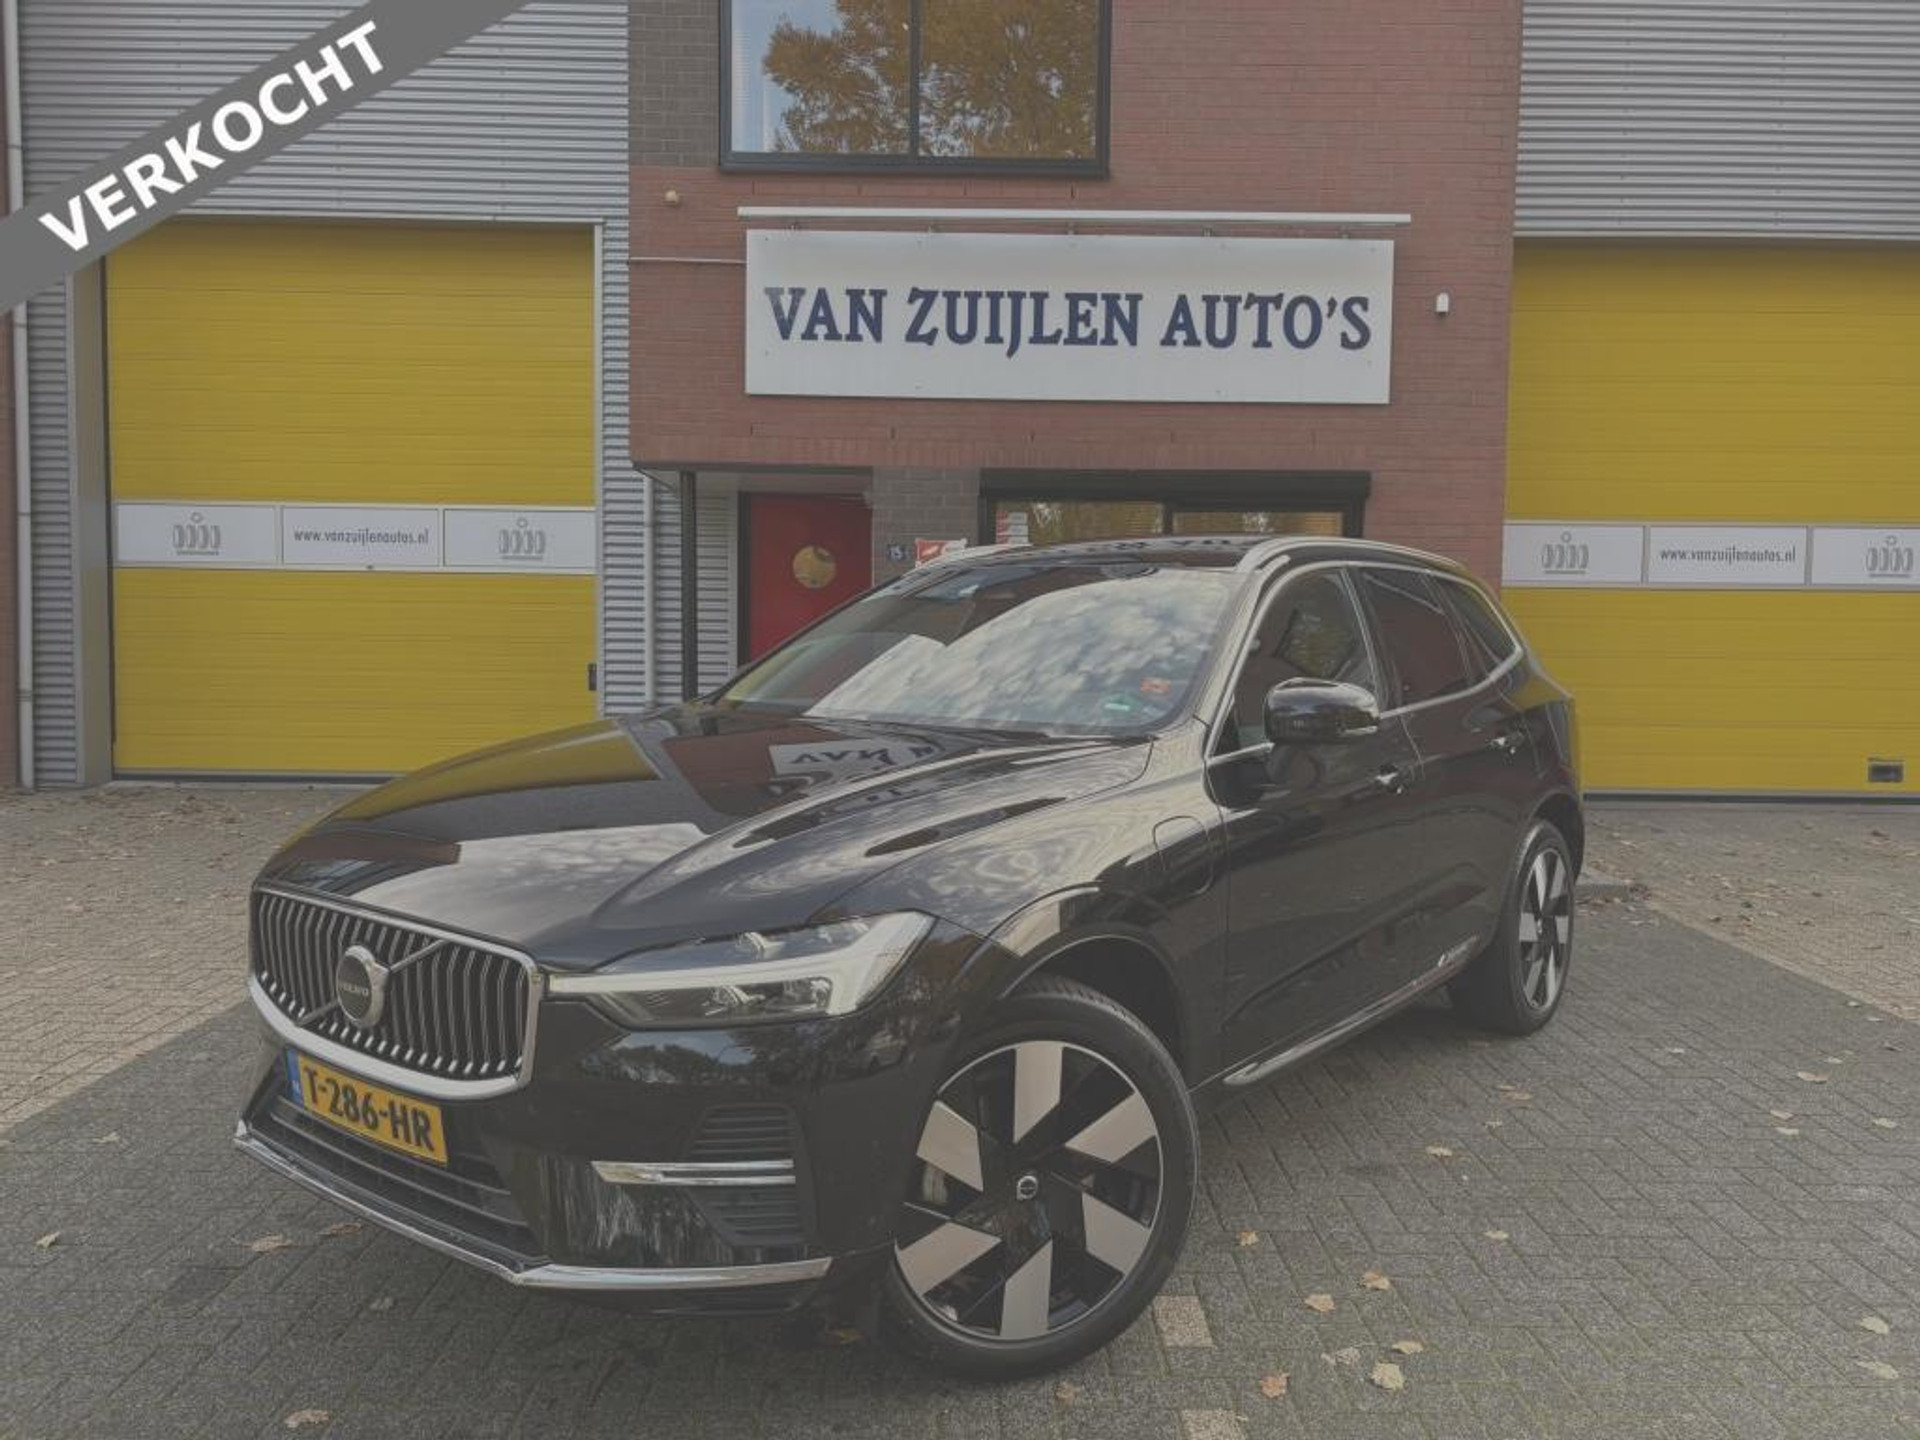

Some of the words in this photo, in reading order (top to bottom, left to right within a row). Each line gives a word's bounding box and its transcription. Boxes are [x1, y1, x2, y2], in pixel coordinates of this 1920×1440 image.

[764, 287, 888, 344] VAN
[904, 286, 1144, 359] ZUIJLEN
[1159, 292, 1372, 351] AUTO'S
[293, 527, 430, 546] www.vanzuijlenautos.nl
[1660, 545, 1796, 565] www.vanzuijlenautos.nl
[303, 1065, 434, 1152] T-286-HR
